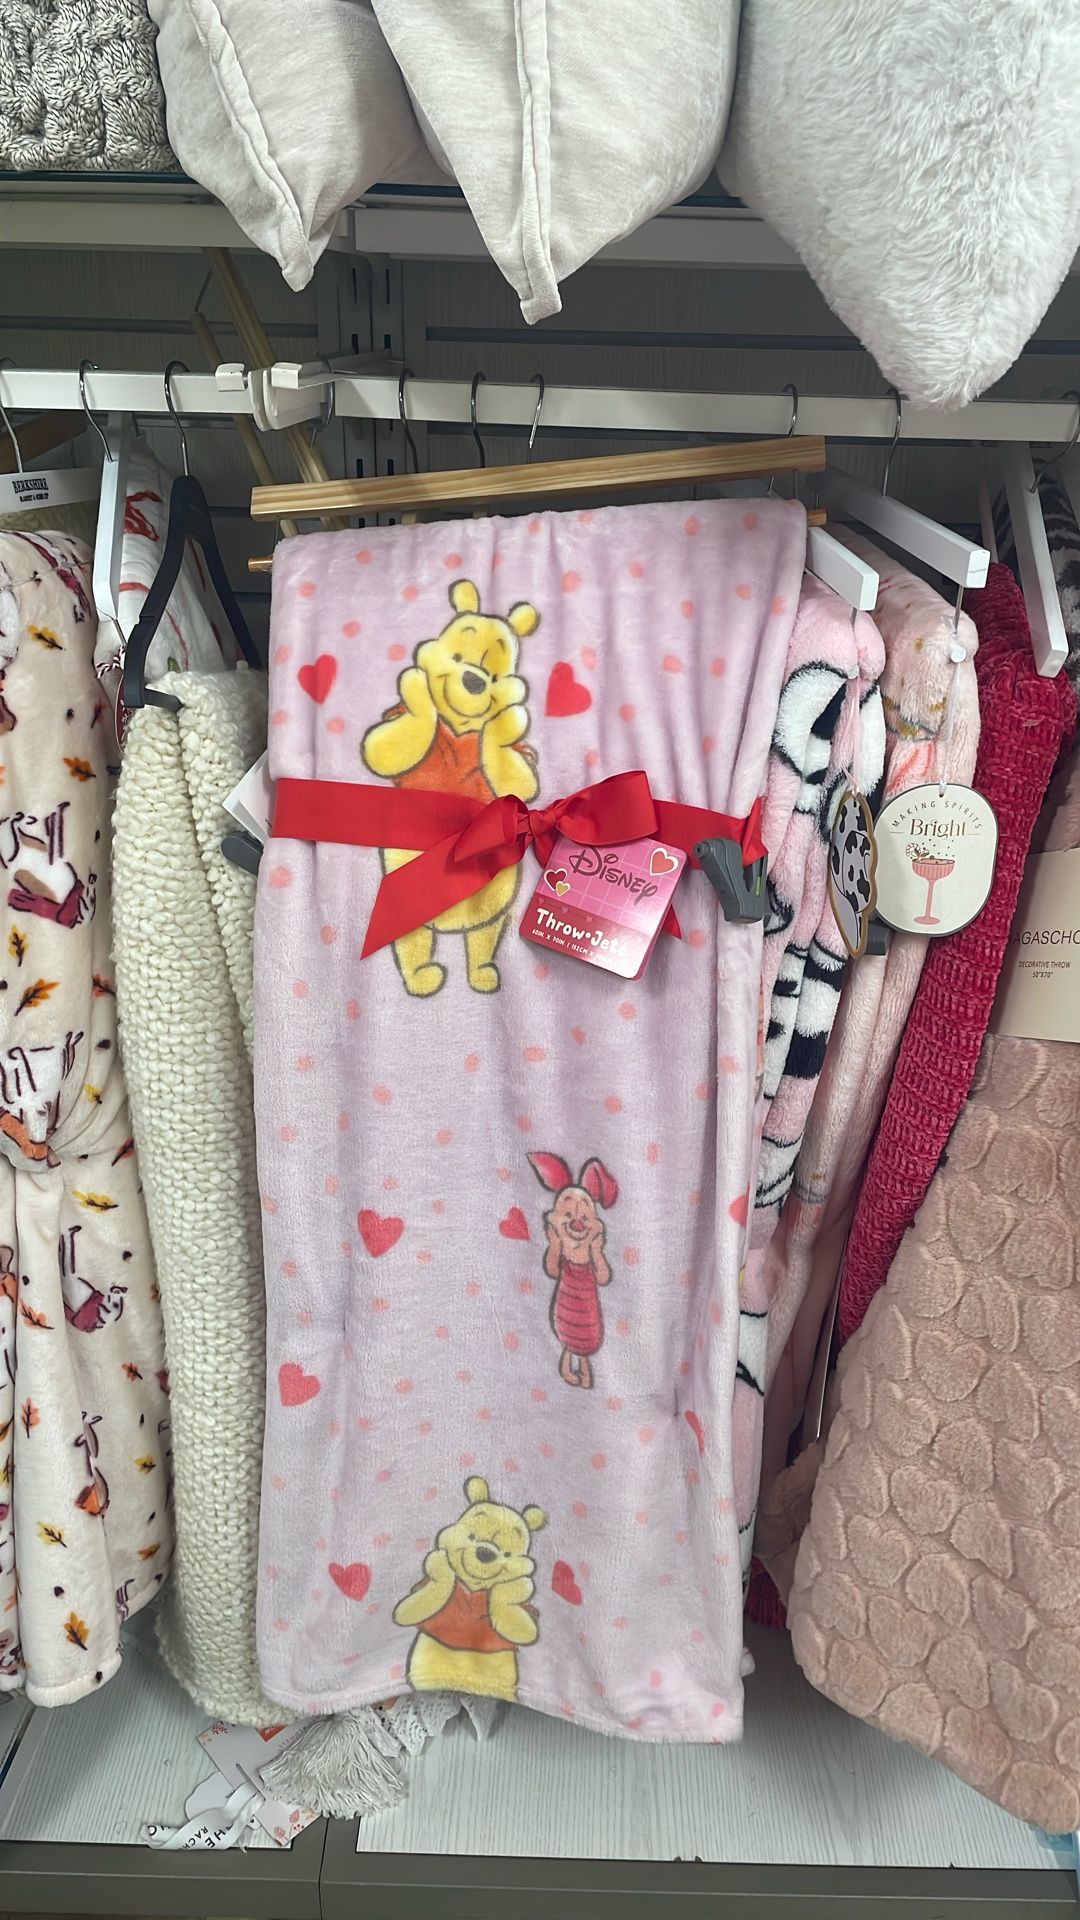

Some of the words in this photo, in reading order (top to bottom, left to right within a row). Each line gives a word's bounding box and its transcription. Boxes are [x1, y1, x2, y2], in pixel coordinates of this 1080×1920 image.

[892, 801, 936, 827] MAKING
[944, 801, 982, 829] SPIRITS
[910, 818, 966, 839] Bright
